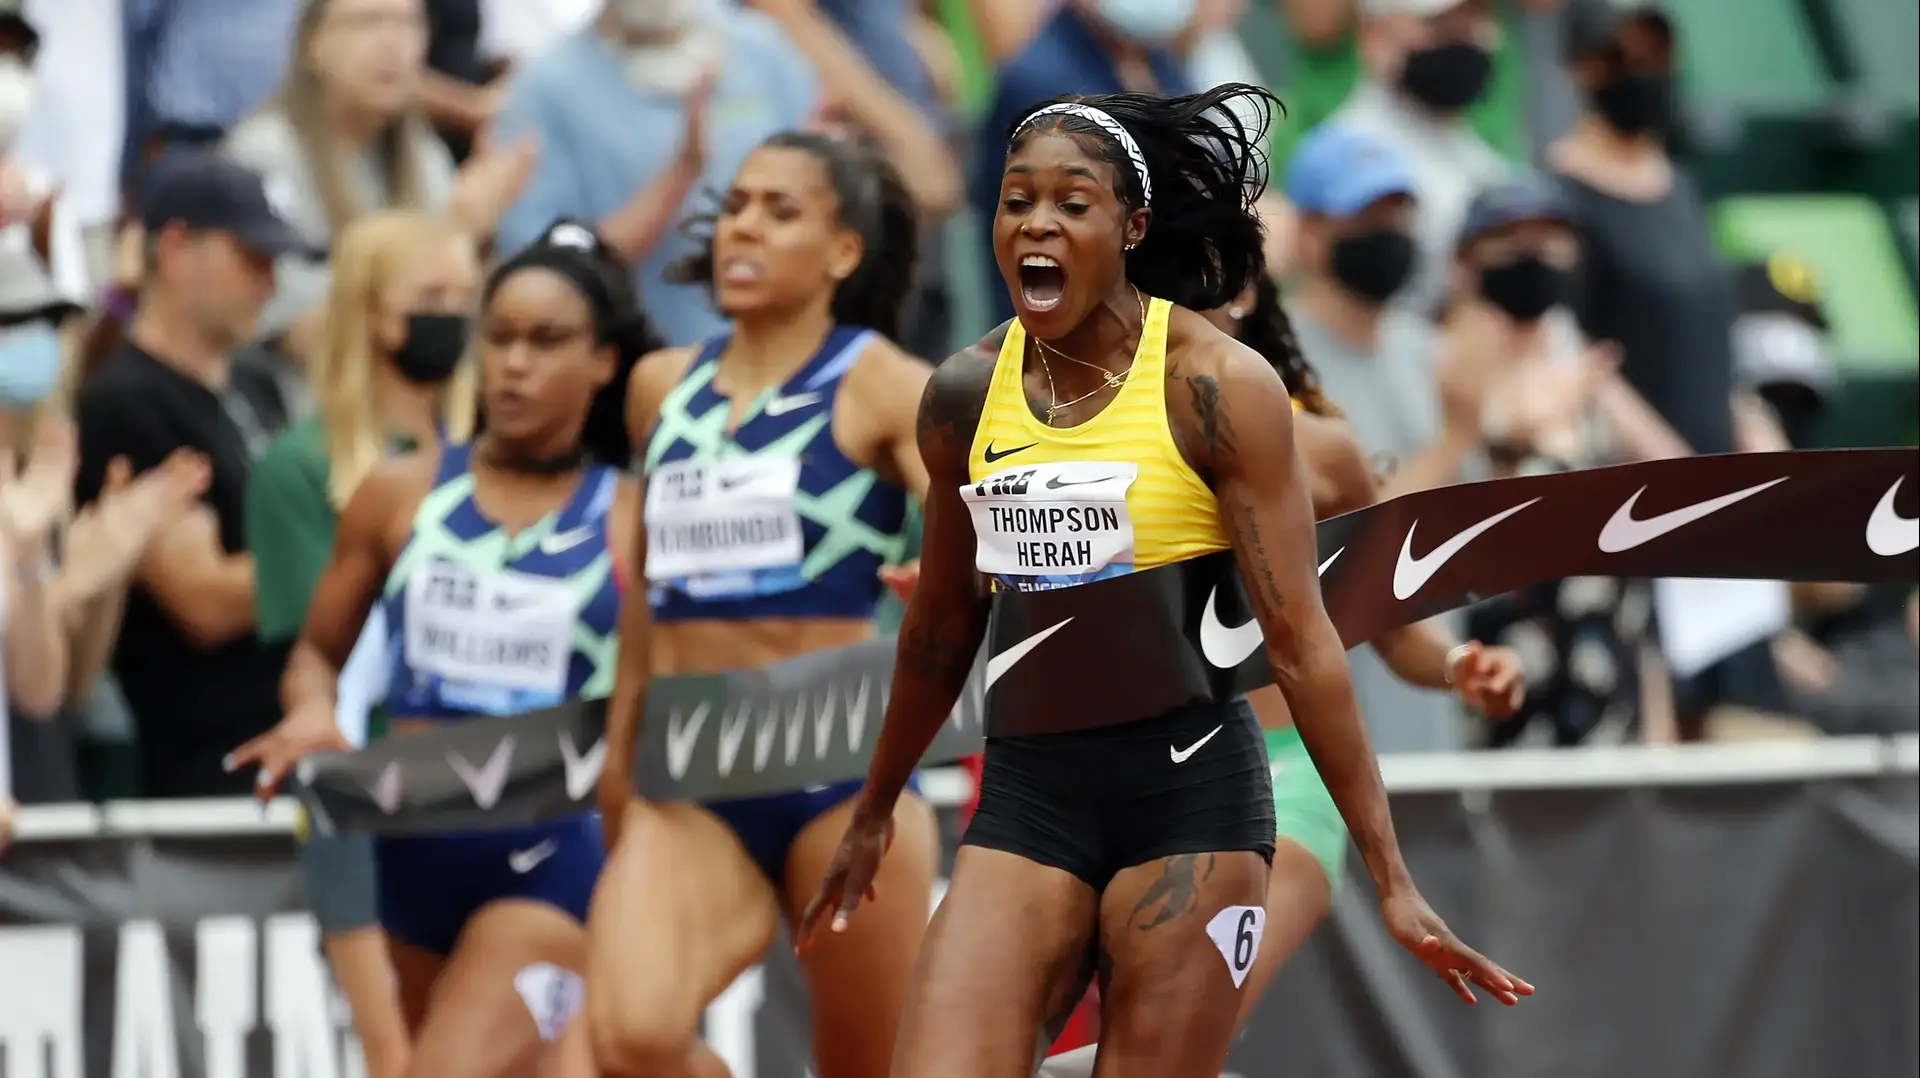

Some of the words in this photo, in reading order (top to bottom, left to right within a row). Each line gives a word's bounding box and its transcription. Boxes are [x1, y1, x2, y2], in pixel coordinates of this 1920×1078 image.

[989, 506, 1119, 534] THOMPSON
[1017, 541, 1092, 567] HERAH
[1234, 909, 1256, 971] 6
